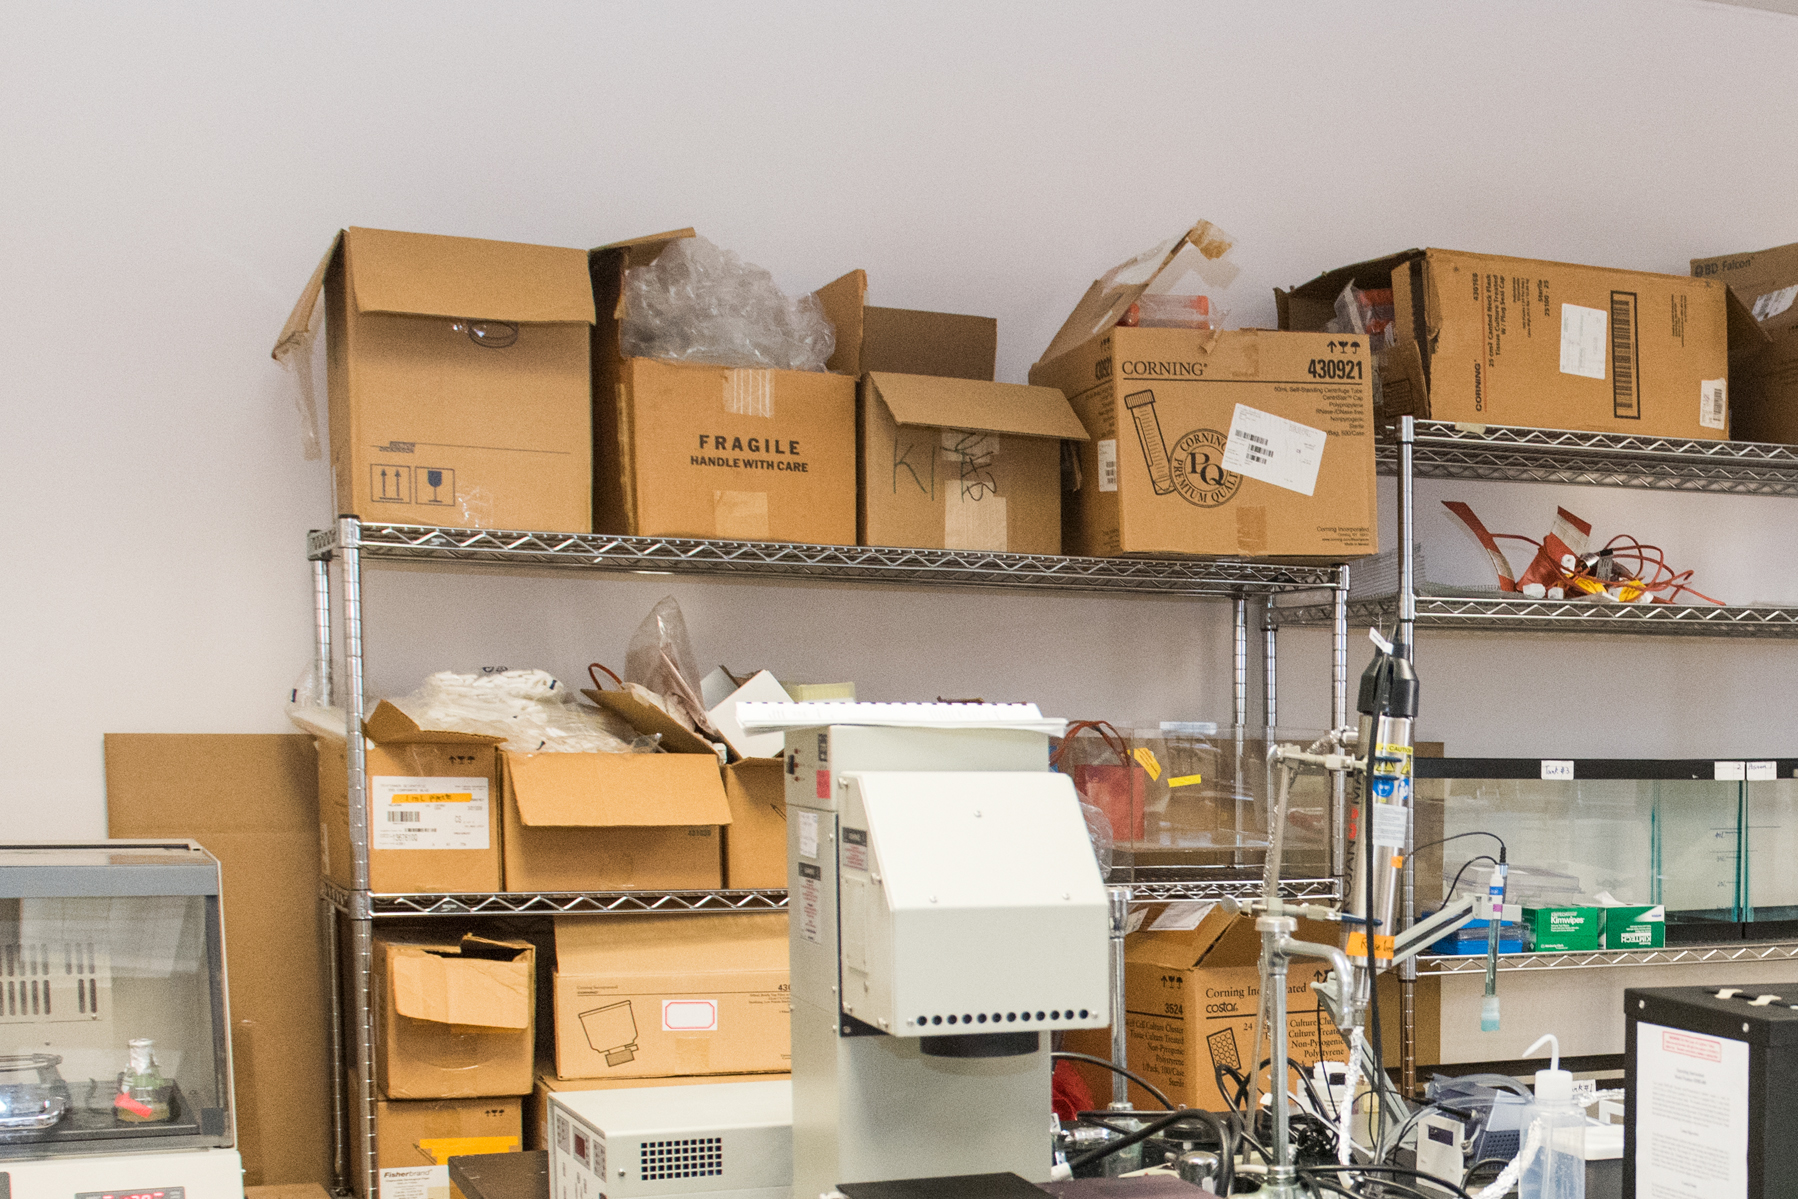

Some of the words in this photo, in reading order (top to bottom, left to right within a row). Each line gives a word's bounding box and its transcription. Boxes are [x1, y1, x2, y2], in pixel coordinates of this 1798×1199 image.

[1704, 263, 1719, 275] BD
[1722, 259, 1751, 272] Falcon
[1122, 361, 1203, 376] CORNING
[1308, 358, 1363, 379] 430921
[1475, 363, 1483, 412] CORNING
[699, 434, 801, 456] FRAGILE
[690, 455, 741, 468] HANDLE
[742, 459, 775, 470] WITH
[777, 461, 809, 473] CARE
[1173, 457, 1208, 503] PREMIUM
[1550, 916, 1586, 925] Kimwipes
[1620, 935, 1652, 944] KIMTECH
[1205, 987, 1245, 1000] Corning
[1247, 983, 1307, 997] Incated
[1165, 1023, 1185, 1034] Cluster
[1243, 1022, 1253, 1032] 24
[1289, 1018, 1317, 1028] Culture
[1288, 1028, 1316, 1039] Culture
[1291, 1037, 1345, 1049] Non-Pyogenic
[383, 1169, 431, 1179] Fisherbrand
